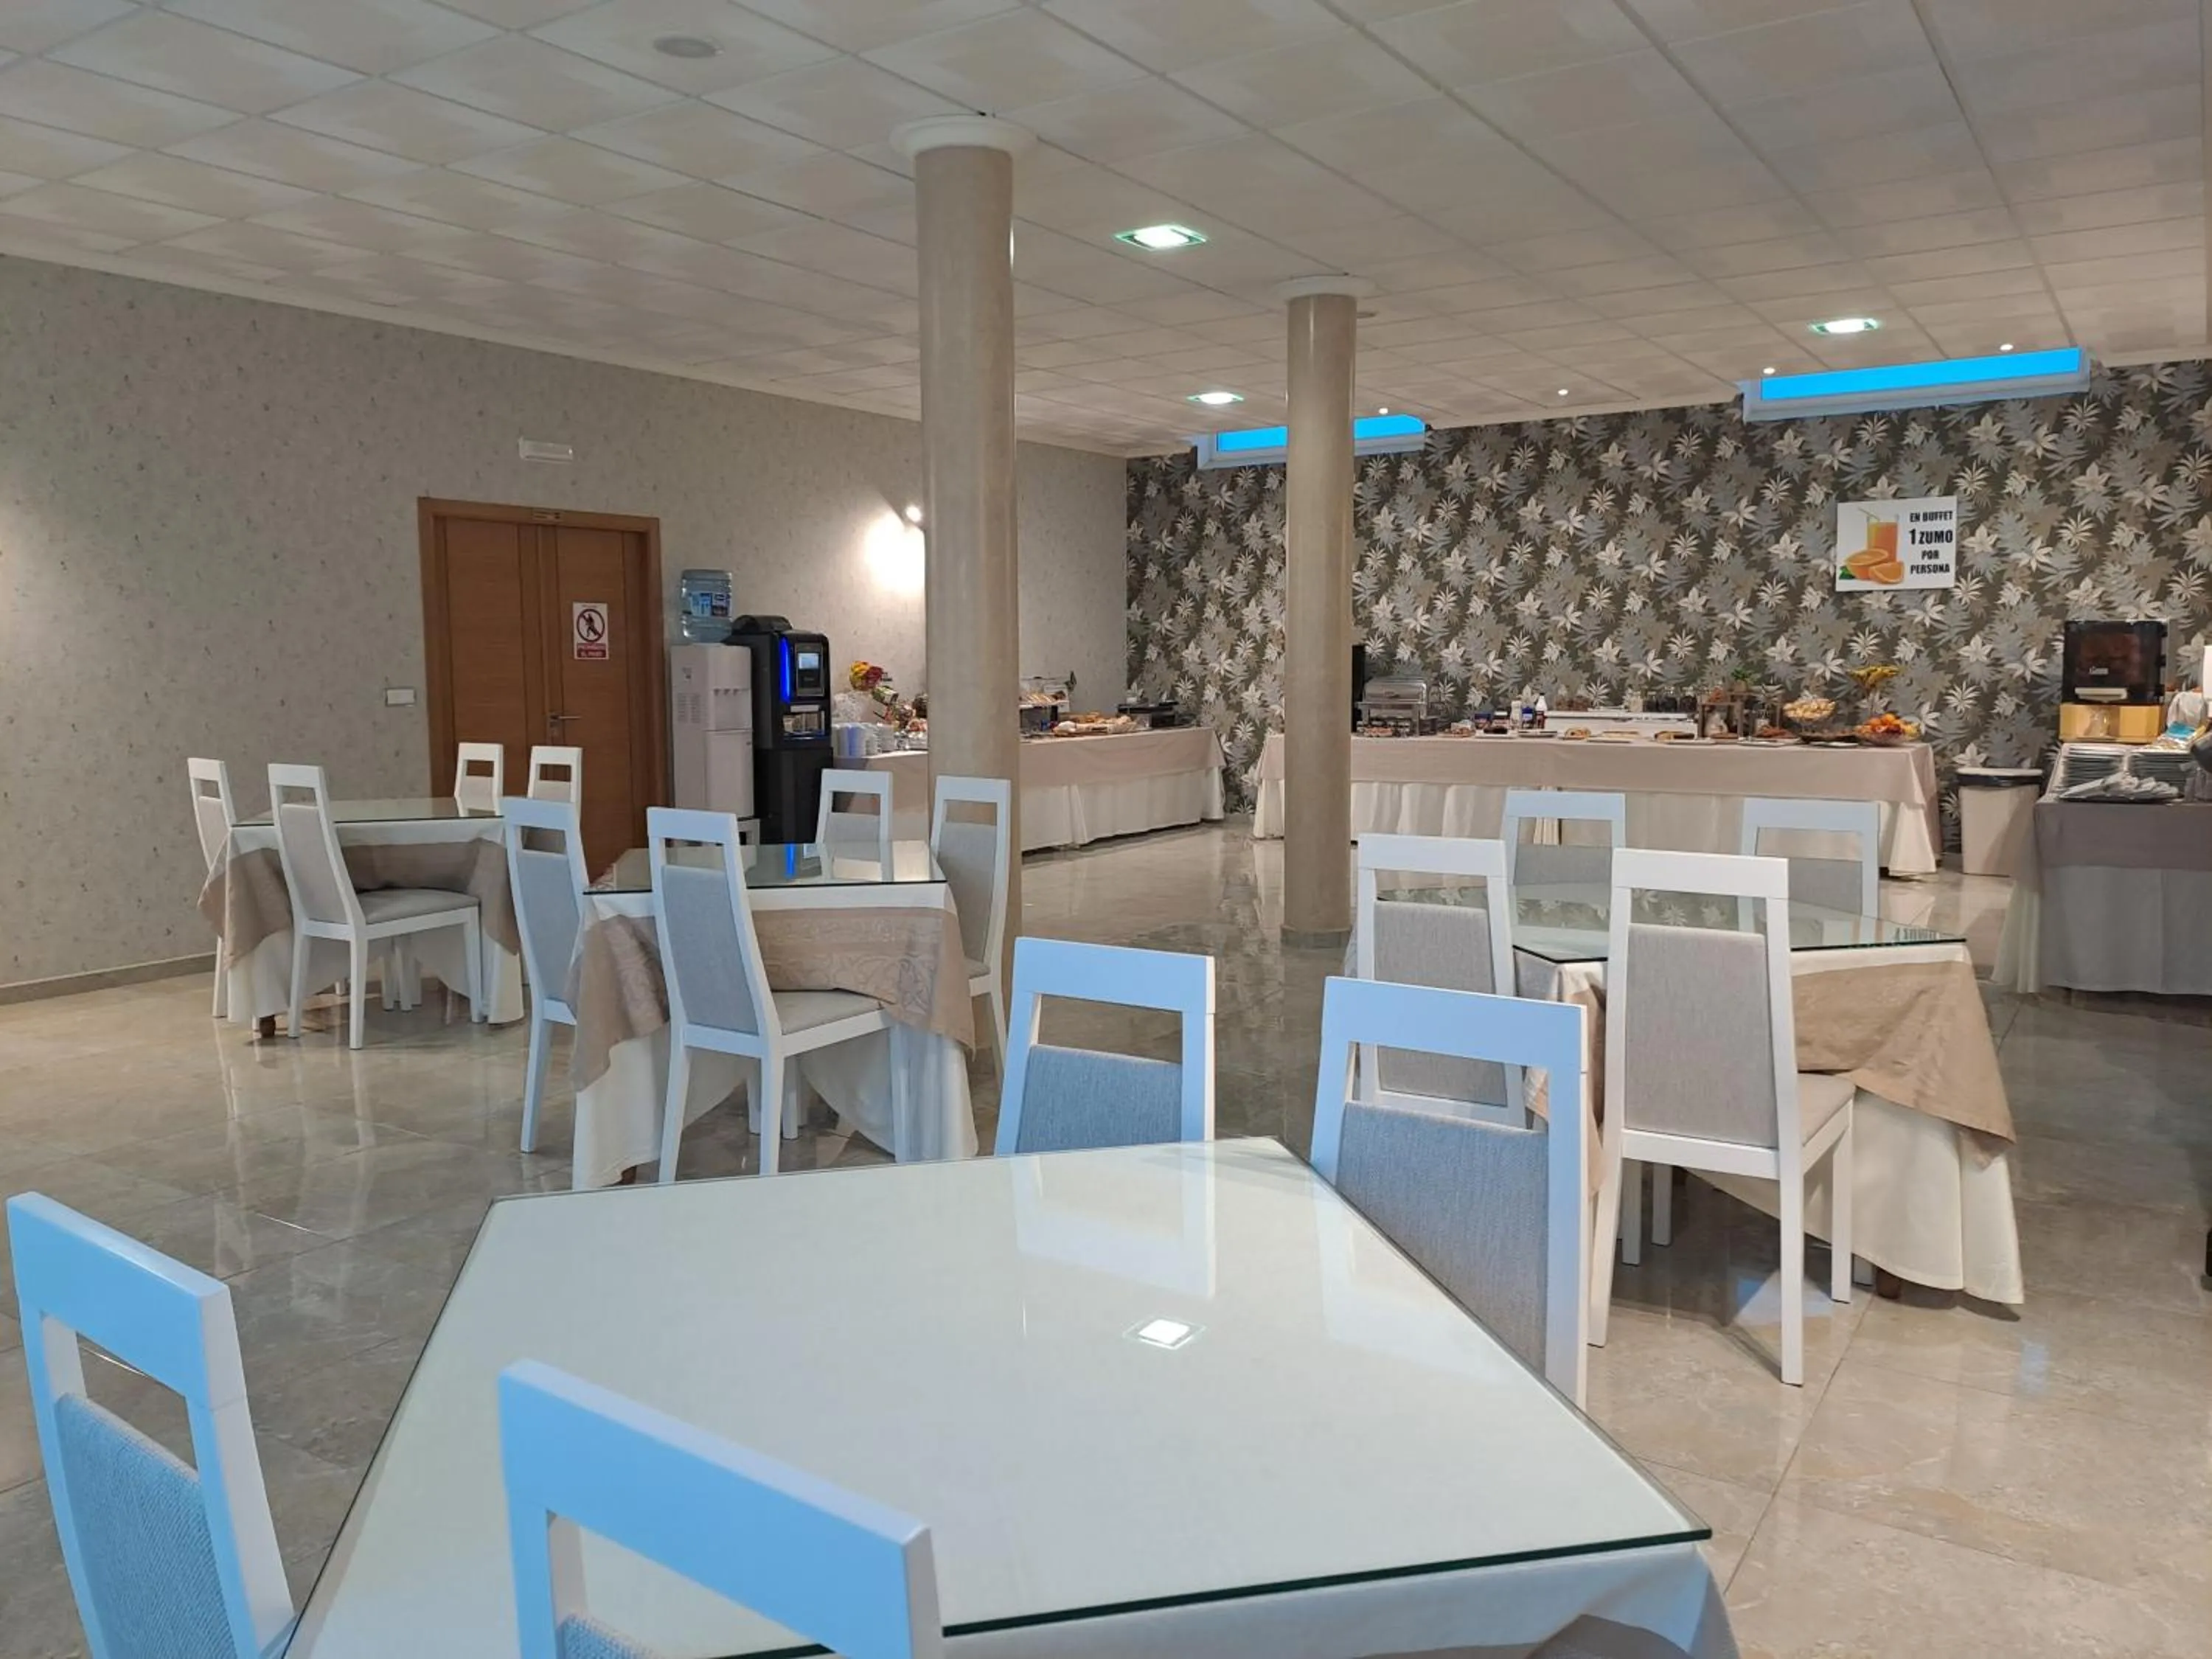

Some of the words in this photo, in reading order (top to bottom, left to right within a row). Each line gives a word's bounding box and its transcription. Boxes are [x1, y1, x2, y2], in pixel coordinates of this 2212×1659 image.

[1910, 512, 1921, 523] EN
[1922, 511, 1953, 522] BUFFET
[1909, 529, 1916, 545] 1
[1919, 529, 1953, 545] ZUMO
[1921, 550, 1939, 560] POR
[1910, 563, 1950, 574] PERSONA
